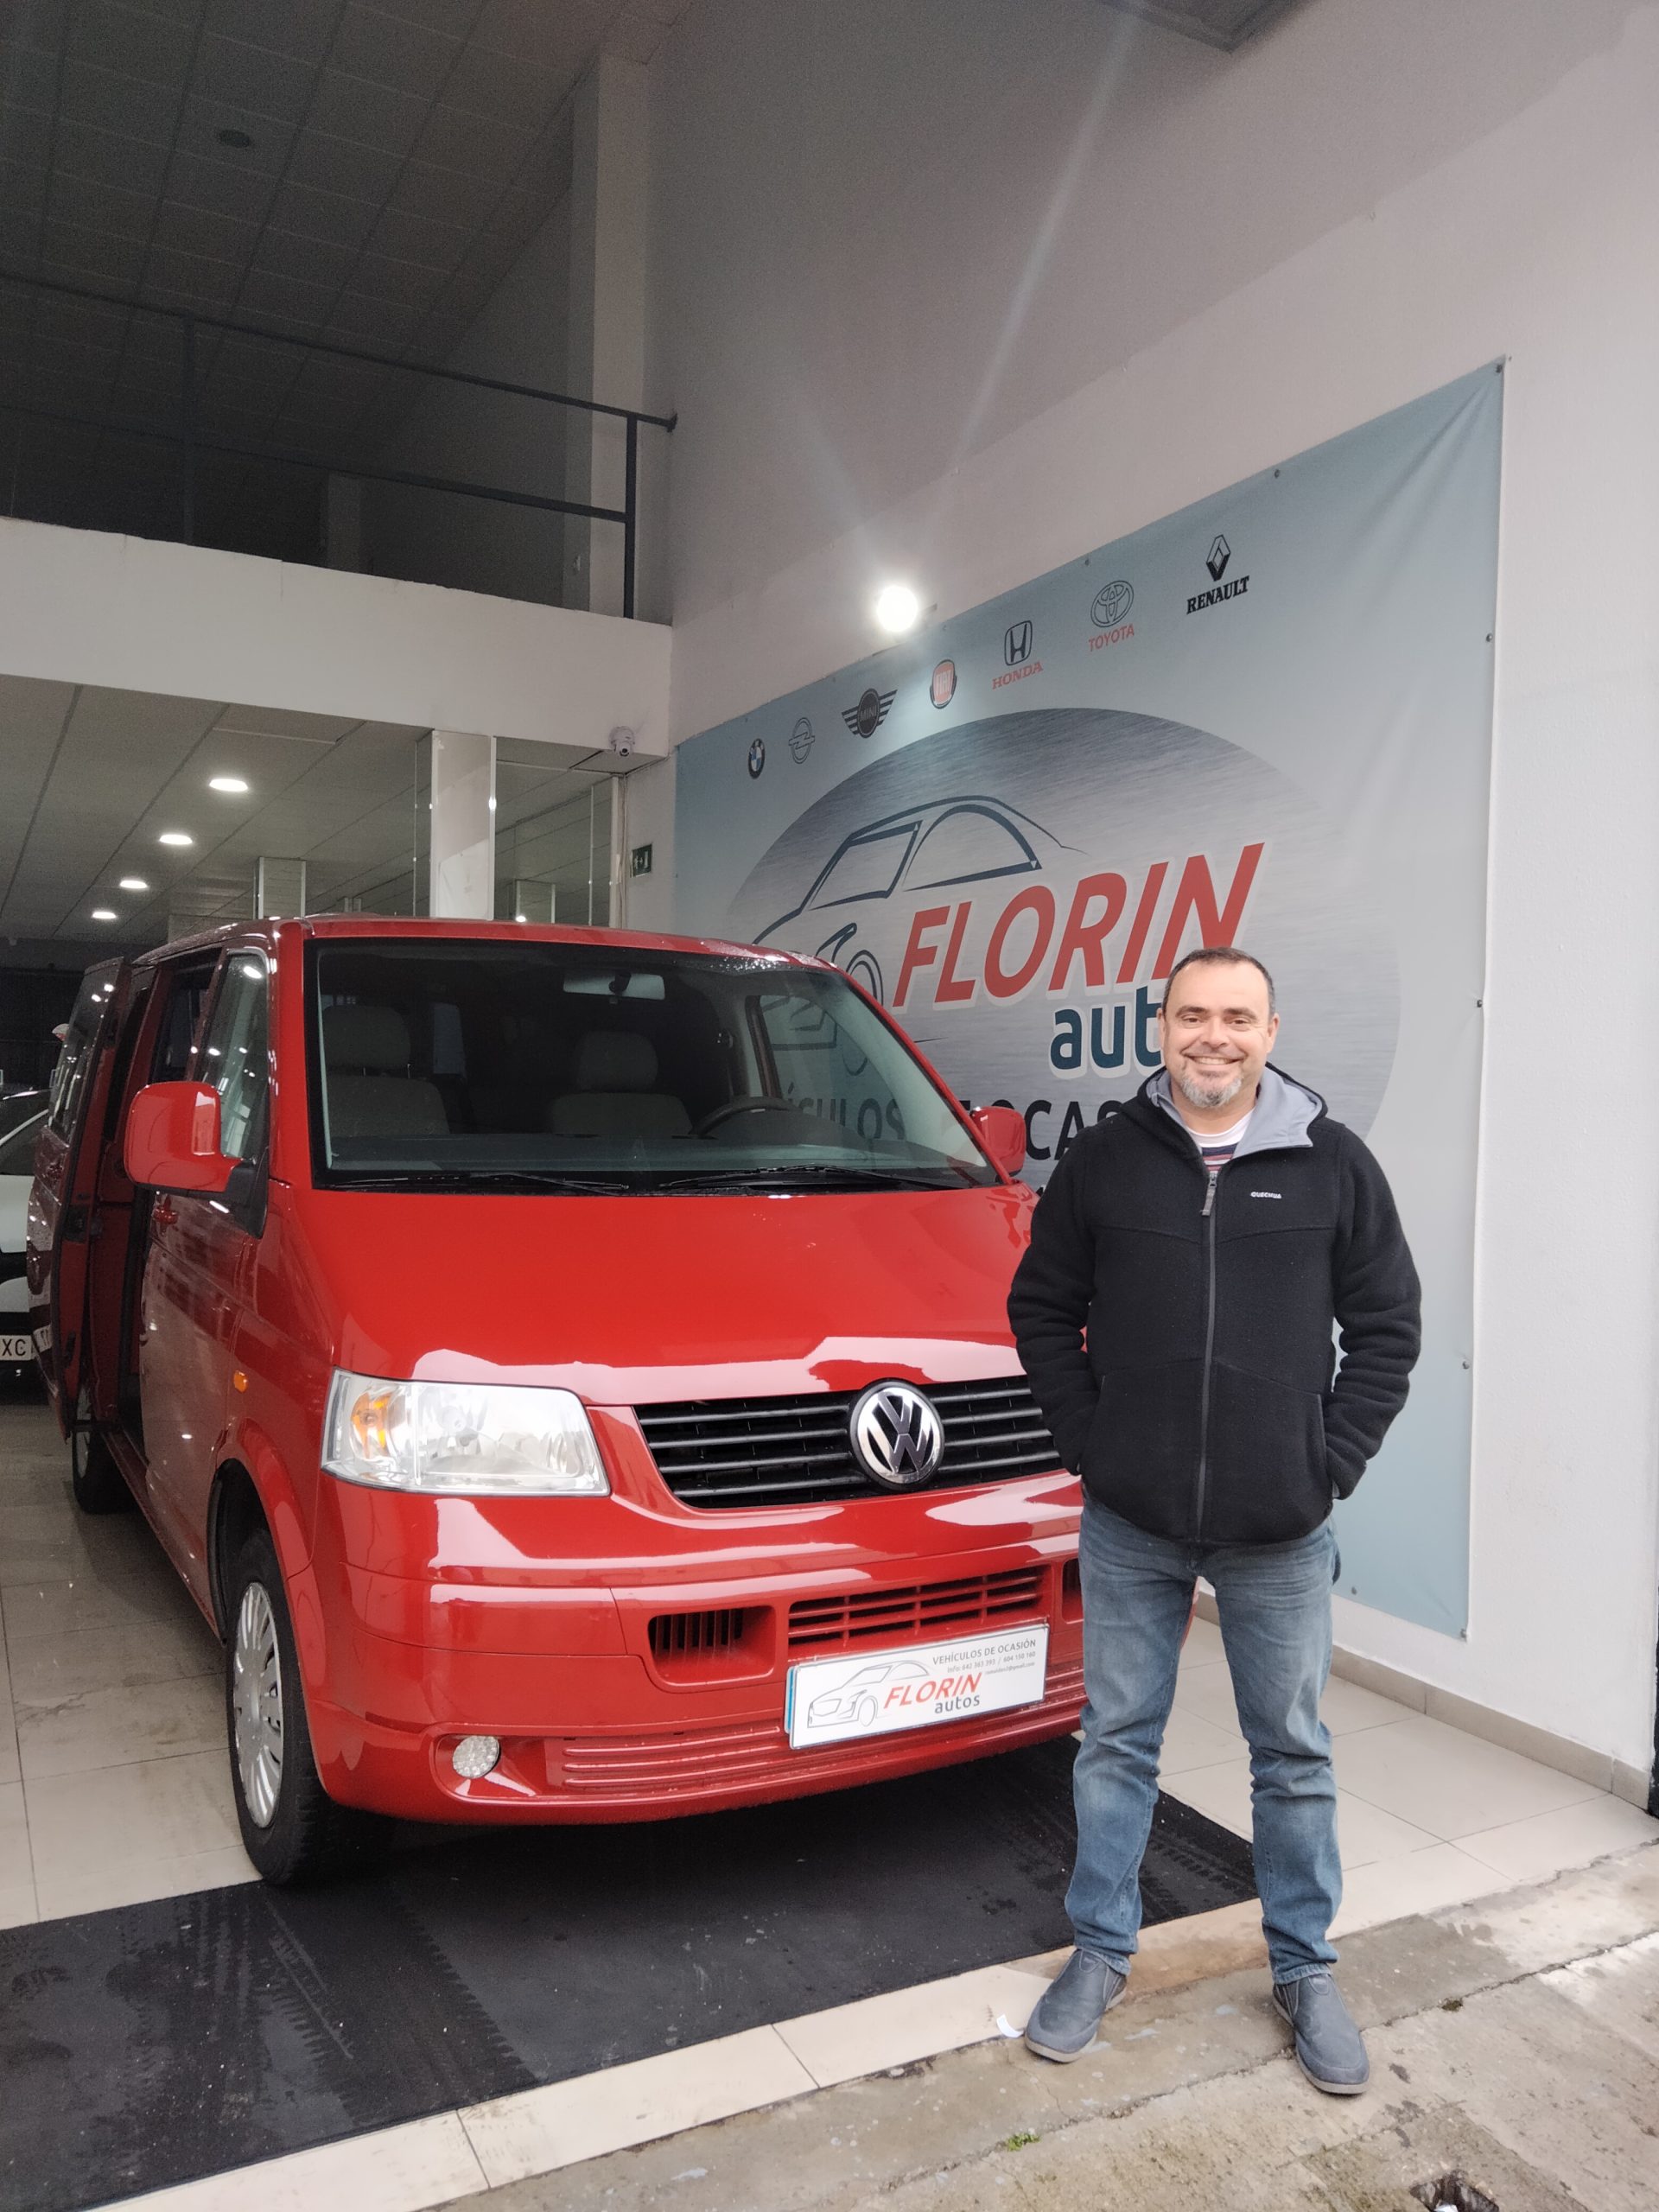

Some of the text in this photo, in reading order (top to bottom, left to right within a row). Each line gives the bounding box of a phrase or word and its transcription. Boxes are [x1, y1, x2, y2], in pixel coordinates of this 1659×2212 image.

[1186, 575, 1250, 615] RENAULT
[1088, 624, 1135, 652] TOYOTA
[992, 661, 1044, 690] HONDA
[892, 842, 1265, 1007] FLORIN
[1049, 986, 1162, 1070] aut
[2, 1338, 27, 1357] XC
[985, 1646, 995, 1656] DE
[997, 1637, 1036, 1654] OCASIÓN
[883, 1671, 982, 1709] FLORIN
[934, 1694, 980, 1714] autos
